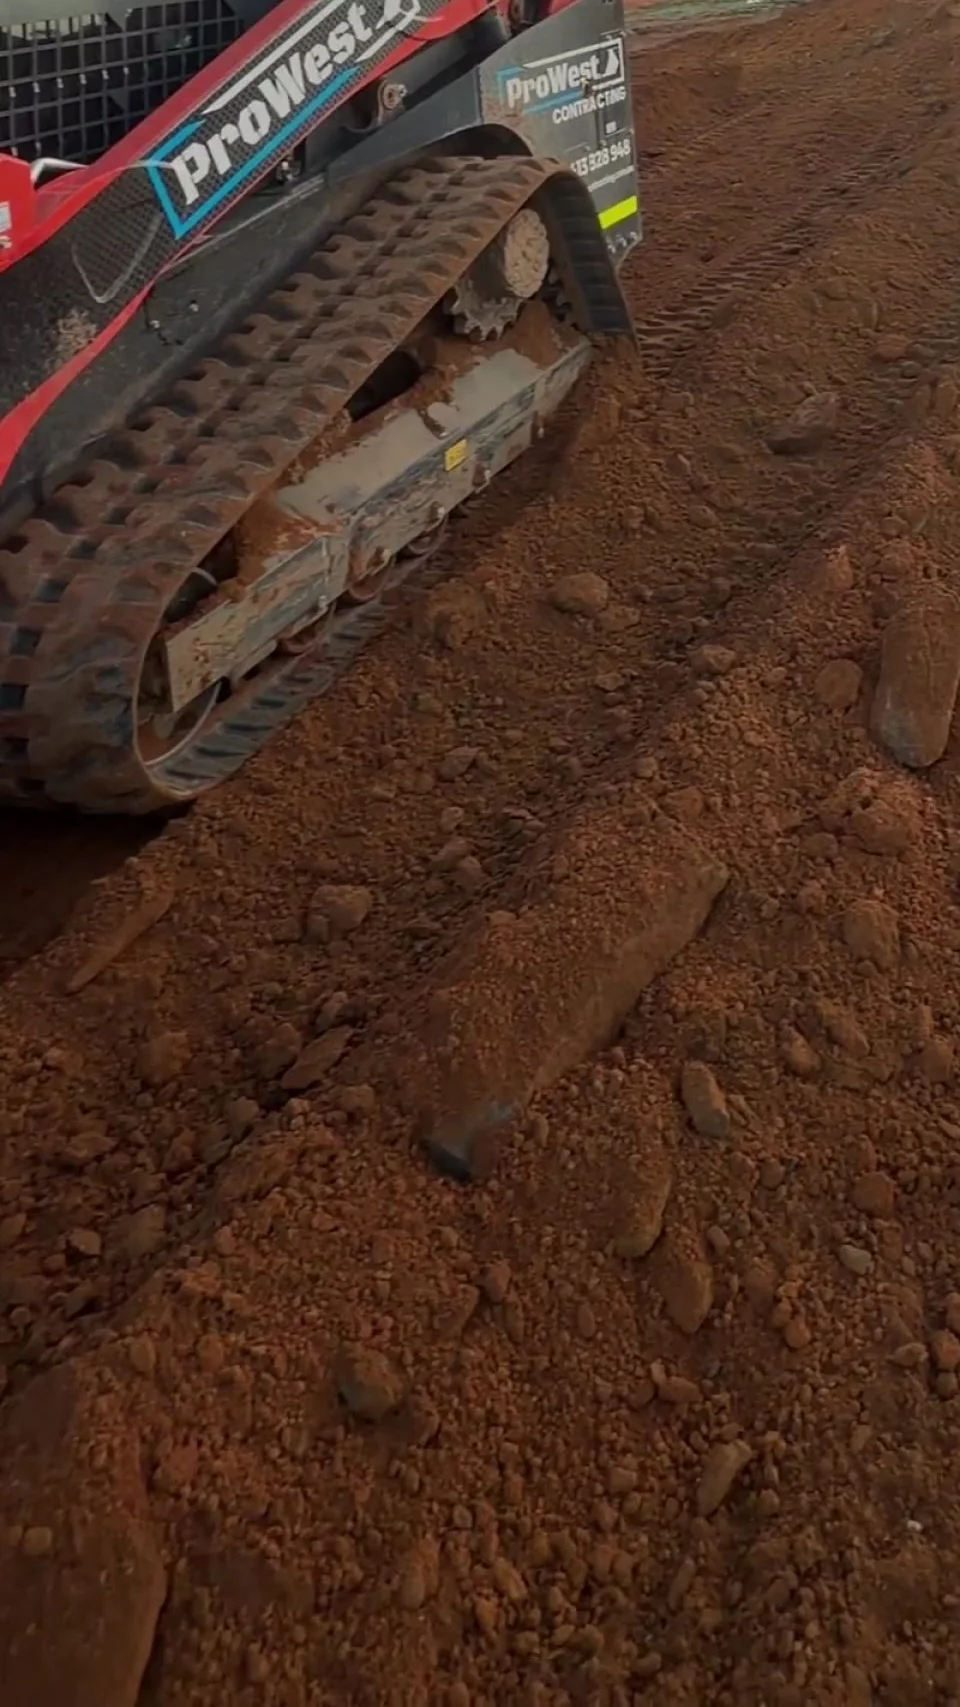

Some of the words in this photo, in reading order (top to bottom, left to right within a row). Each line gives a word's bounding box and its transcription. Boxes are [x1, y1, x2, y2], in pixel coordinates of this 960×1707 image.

[170, 1, 373, 207] ProWest
[506, 54, 601, 109] ProWest
[552, 86, 627, 125] CONTRACTING
